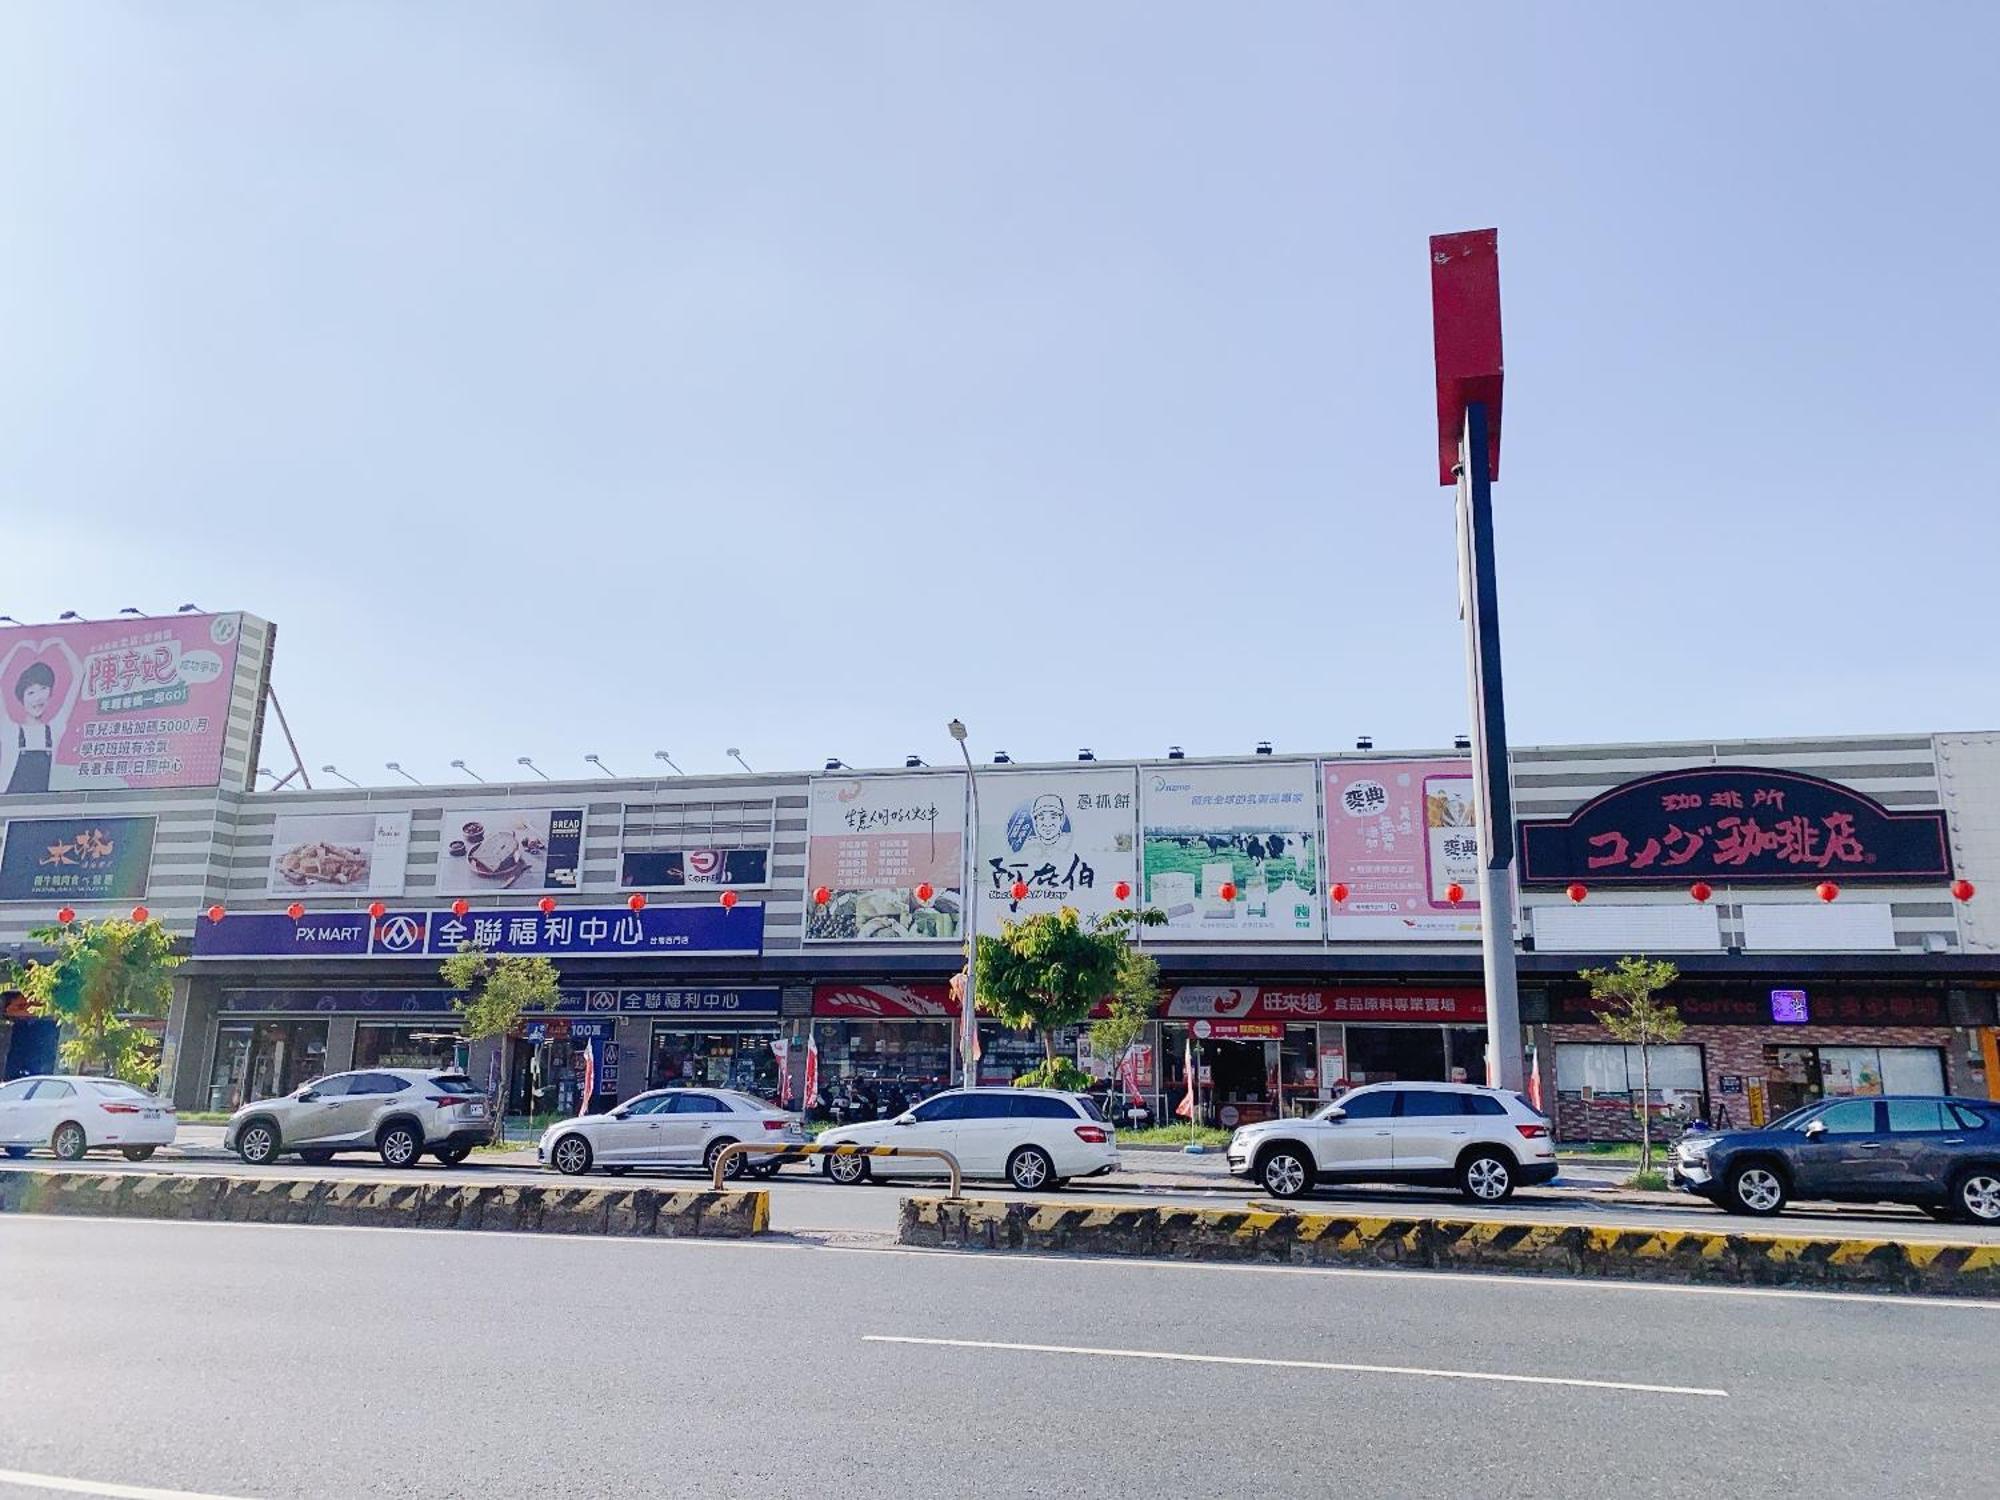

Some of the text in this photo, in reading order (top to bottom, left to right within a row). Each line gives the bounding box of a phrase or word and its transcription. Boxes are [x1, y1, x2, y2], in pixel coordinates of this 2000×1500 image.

[88, 646, 177, 695] 陳亭妃
[552, 819, 580, 829] BREAD
[296, 927, 361, 941] PX MART
[438, 916, 644, 949] 全聯福利中心
[624, 993, 740, 1010] 全聯福利中心
